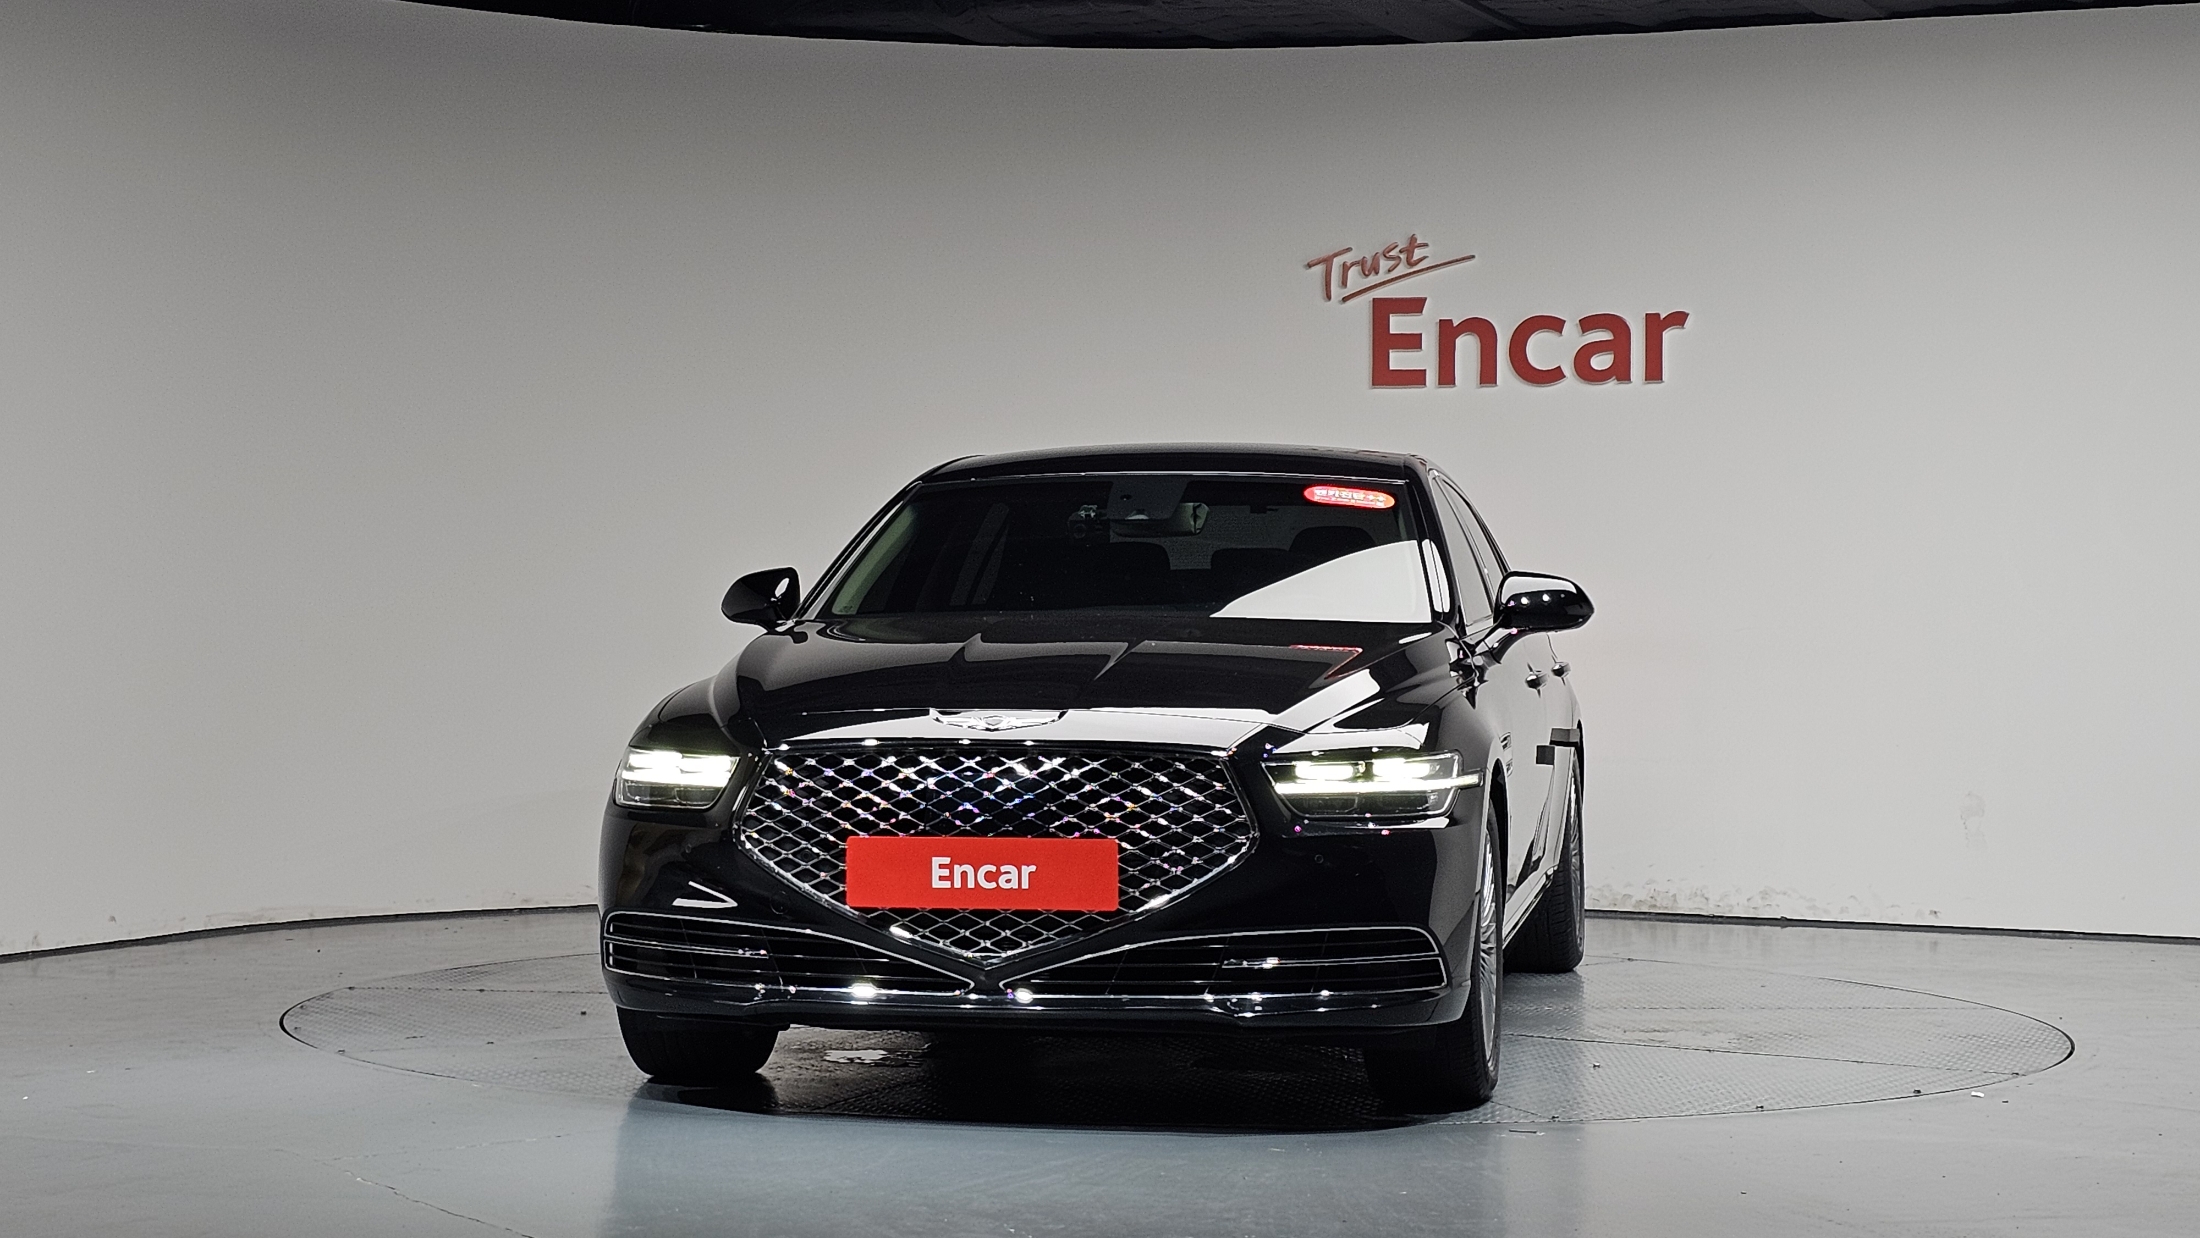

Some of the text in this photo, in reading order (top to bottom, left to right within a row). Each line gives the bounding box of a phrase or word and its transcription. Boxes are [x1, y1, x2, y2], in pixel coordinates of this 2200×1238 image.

[1306, 233, 1429, 301] Trust
[1371, 296, 1690, 388] Encar
[931, 856, 1037, 890] Encar
